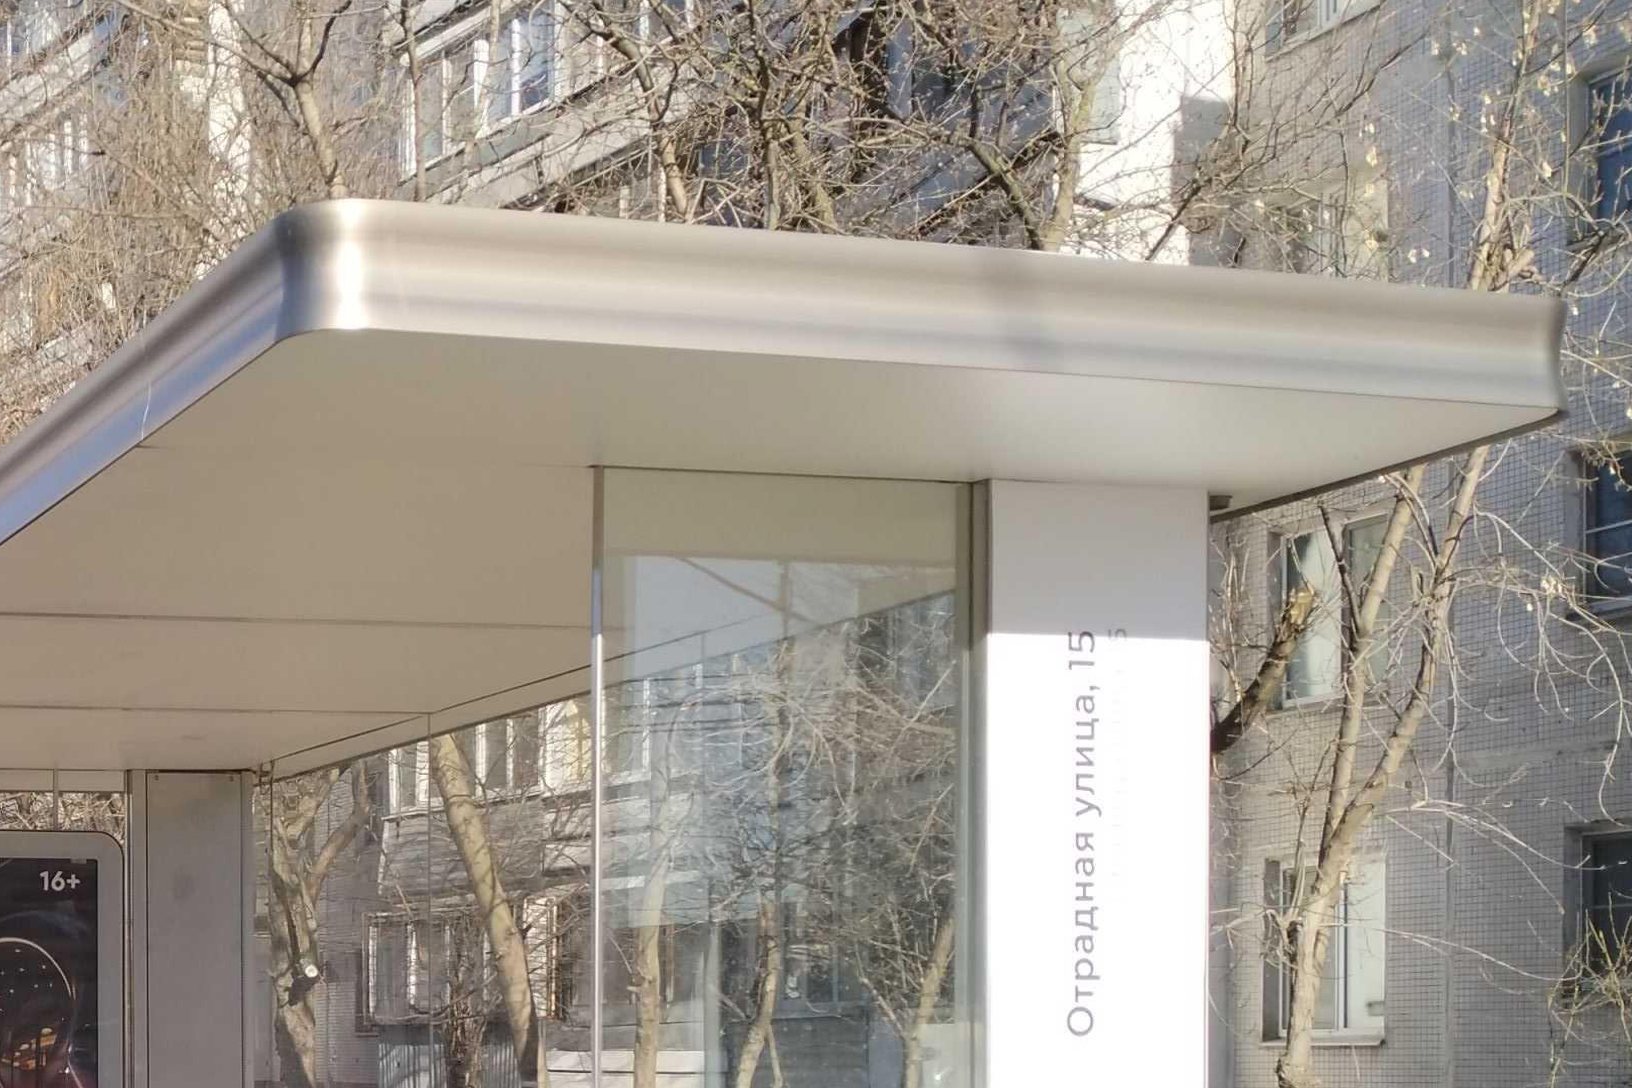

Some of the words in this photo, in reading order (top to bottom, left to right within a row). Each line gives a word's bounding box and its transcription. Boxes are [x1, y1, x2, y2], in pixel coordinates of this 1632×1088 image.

[1067, 630, 1096, 671] 15
[1074, 685, 1102, 818] улица,
[39, 870, 81, 892] 16+
[1066, 831, 1100, 1037] Отрадная
